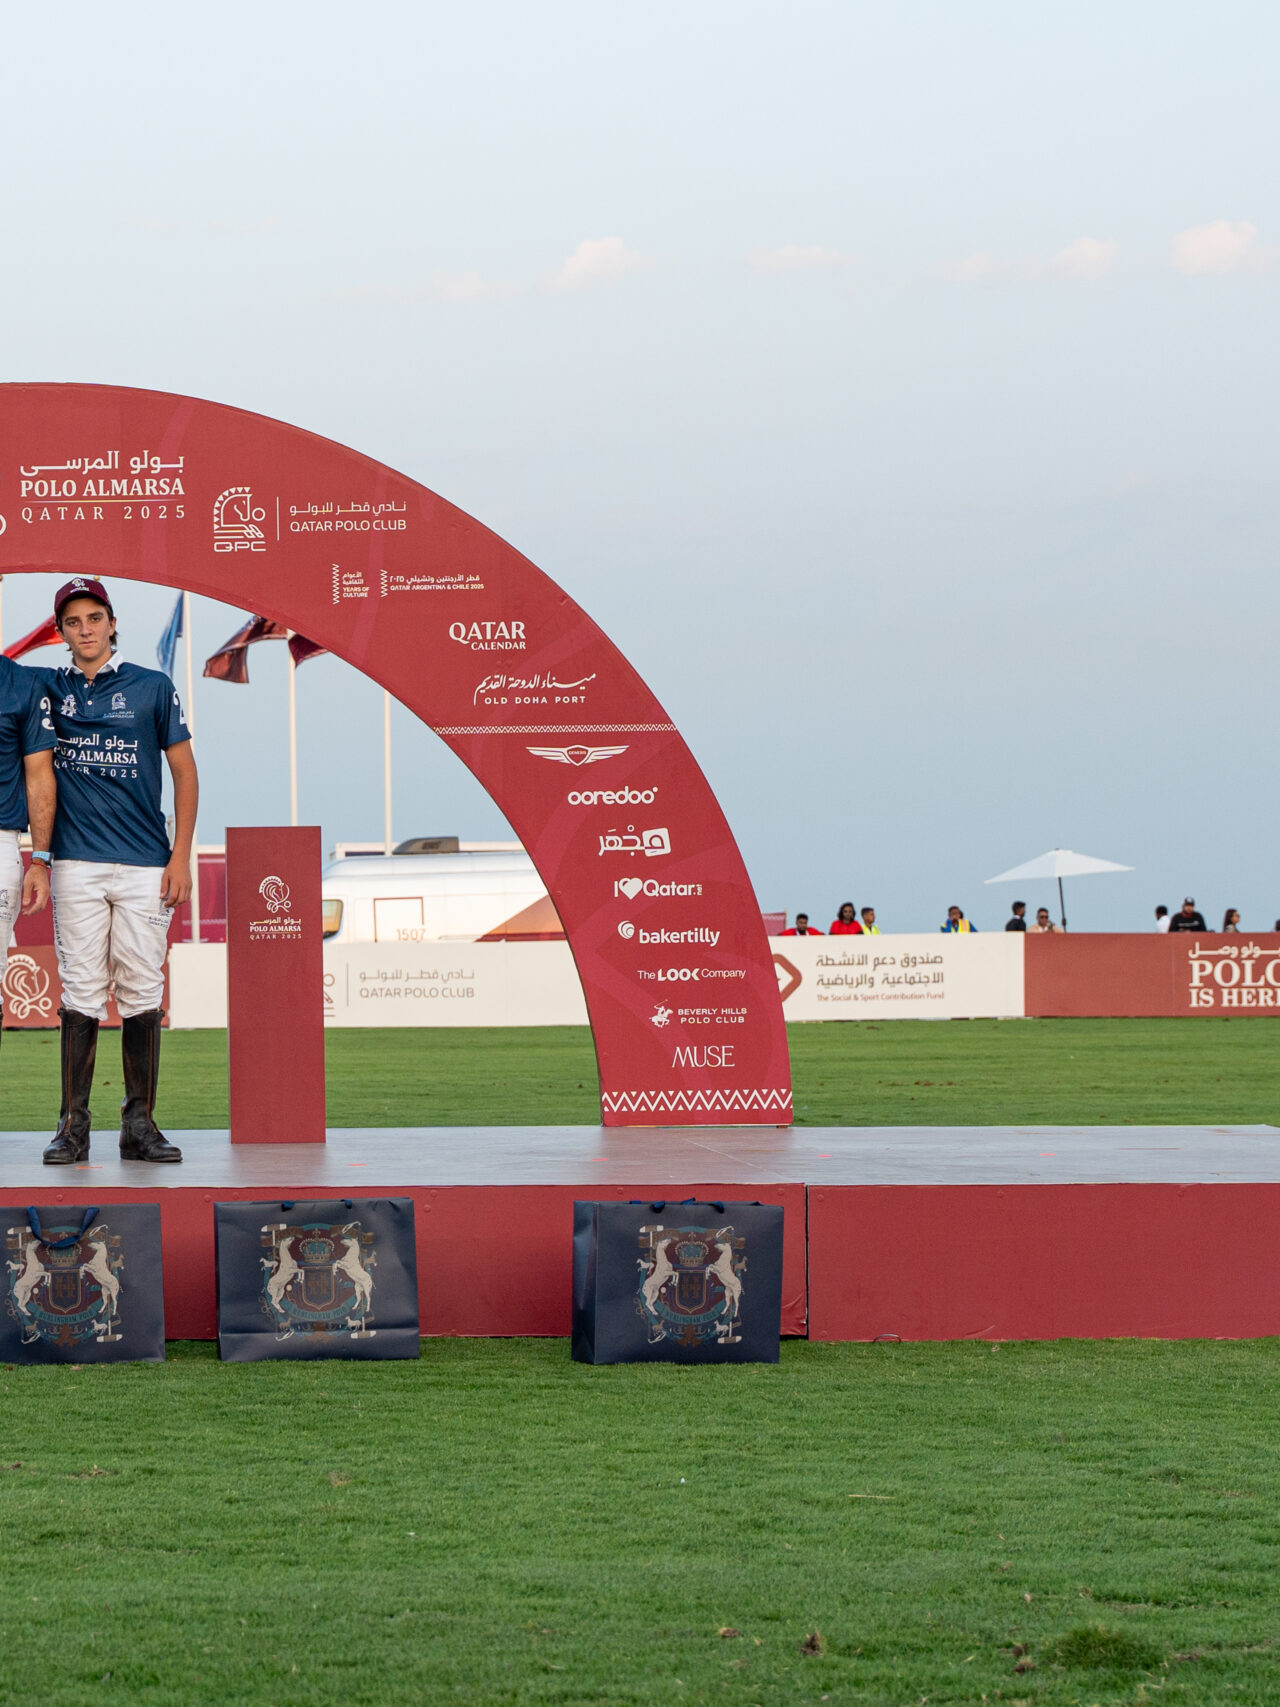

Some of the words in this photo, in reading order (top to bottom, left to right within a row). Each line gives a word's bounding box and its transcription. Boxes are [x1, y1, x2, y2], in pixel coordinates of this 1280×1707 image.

[20, 450, 120, 476] المرسى
[129, 450, 184, 475] بولو
[20, 479, 77, 498] POLO
[82, 477, 185, 496] ALMARSA
[21, 506, 104, 524] QATAR
[123, 505, 185, 519] 2025
[289, 502, 333, 516] للبولو
[336, 502, 370, 516] قطر
[372, 501, 407, 516] نادي
[290, 521, 333, 532] QATAR
[335, 520, 370, 531] POLO
[372, 519, 407, 531] CLUB
[214, 541, 267, 552] QPC
[448, 620, 526, 644] QATAR
[471, 641, 526, 650] CALENDAR
[484, 697, 508, 705] OLD
[515, 696, 548, 704] DOHA
[555, 696, 586, 704] PORT
[78, 750, 138, 764] ALMARSA
[100, 768, 137, 778] 2025
[568, 785, 659, 806] ooredoo
[396, 929, 427, 941] 1507
[639, 927, 720, 947] bakertilly
[873, 956, 896, 971] دعم
[900, 952, 943, 968] صندوق
[405, 969, 439, 982] قطر
[441, 968, 475, 984] نادي
[637, 970, 655, 980] The
[701, 968, 746, 979] Company
[360, 987, 401, 999] QATAR
[404, 987, 439, 998] POLO
[442, 987, 475, 998] CLUB
[860, 994, 879, 1003] Sport
[880, 992, 925, 1000] Contribution
[926, 991, 944, 1000] Fund
[1189, 988, 1215, 1008] IS
[677, 1008, 718, 1016] BEVERLY
[721, 1007, 747, 1015] HILLS
[680, 1016, 711, 1024] POLO
[672, 1045, 735, 1068] MUSE
